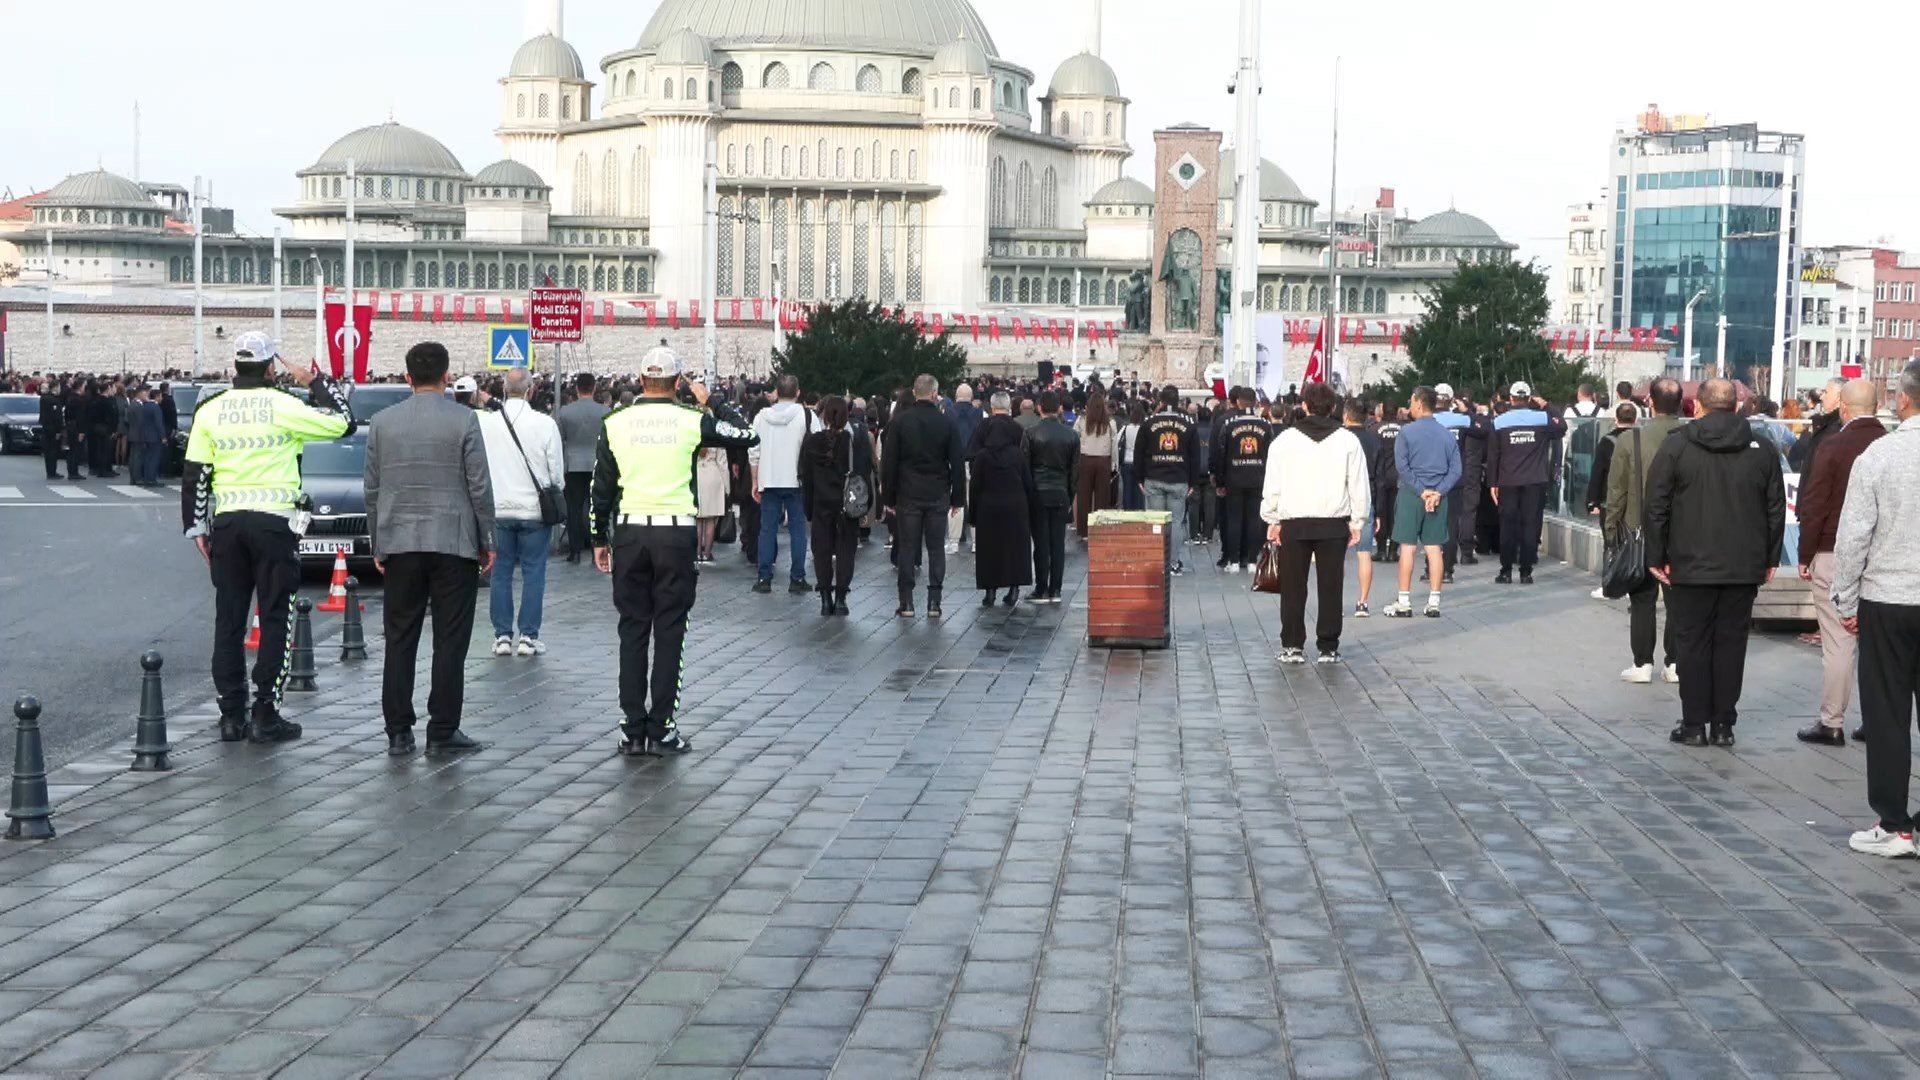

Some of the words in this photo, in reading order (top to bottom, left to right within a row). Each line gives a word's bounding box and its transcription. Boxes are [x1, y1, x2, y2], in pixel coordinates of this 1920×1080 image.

[532, 291, 541, 300] Bu
[534, 305, 553, 314] Mobil
[570, 305, 579, 314] ile
[541, 317, 572, 326] Denetim
[314, 543, 325, 552] VA
